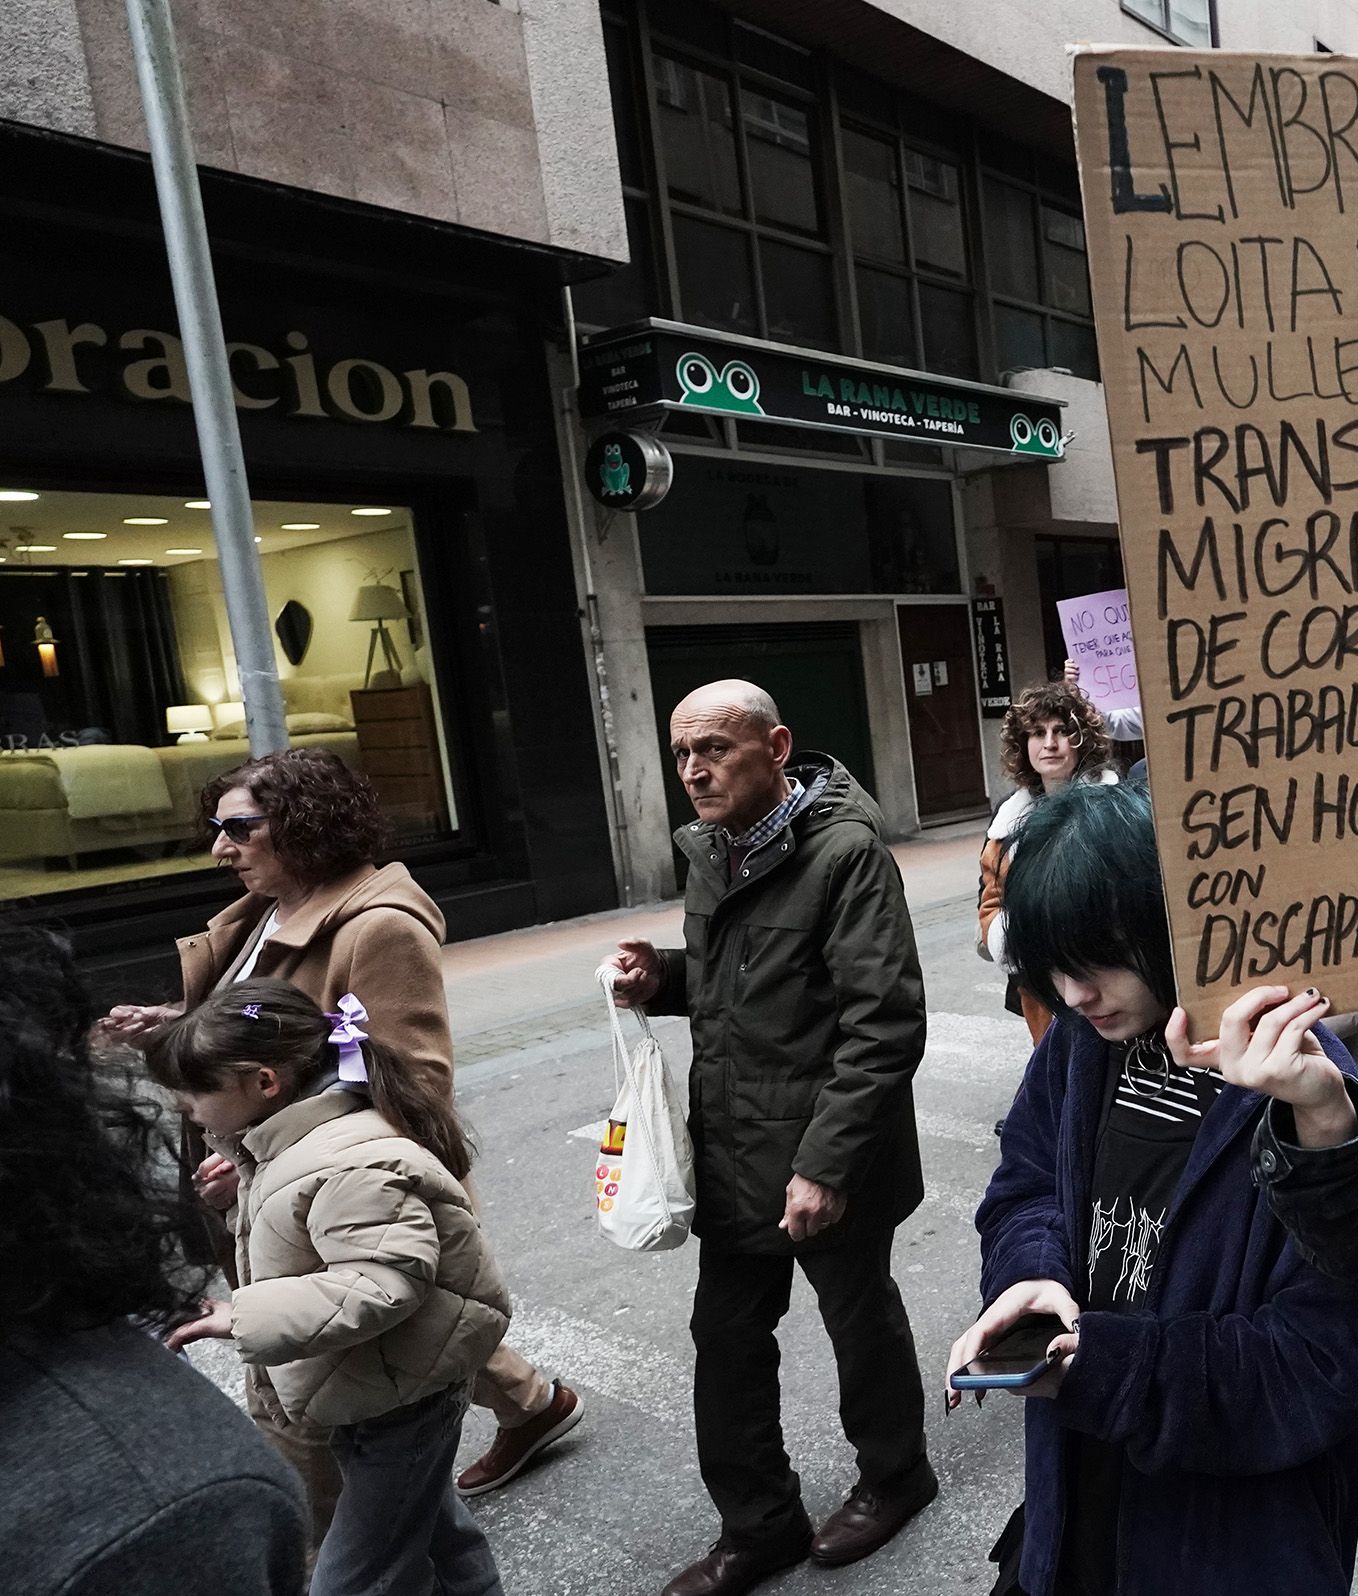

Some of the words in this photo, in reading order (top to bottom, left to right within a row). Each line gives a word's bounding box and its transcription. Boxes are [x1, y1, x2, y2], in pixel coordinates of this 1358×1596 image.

[1124, 233, 1343, 333] LOITA
[602, 380, 639, 395] VINOTECA
[611, 366, 626, 377] BAR
[802, 371, 835, 399] LA
[839, 378, 907, 411] RANA
[910, 391, 980, 424] VERDE
[827, 403, 851, 417] BAR
[860, 408, 915, 427] VINOTECA
[923, 418, 964, 435] TAPERÍA
[976, 601, 996, 612] BAR
[1071, 610, 1095, 635] NO
[1096, 649, 1114, 659] PARA
[1167, 611, 1247, 700] DE
[1182, 773, 1298, 860] SEN
[1187, 863, 1265, 910] CON
